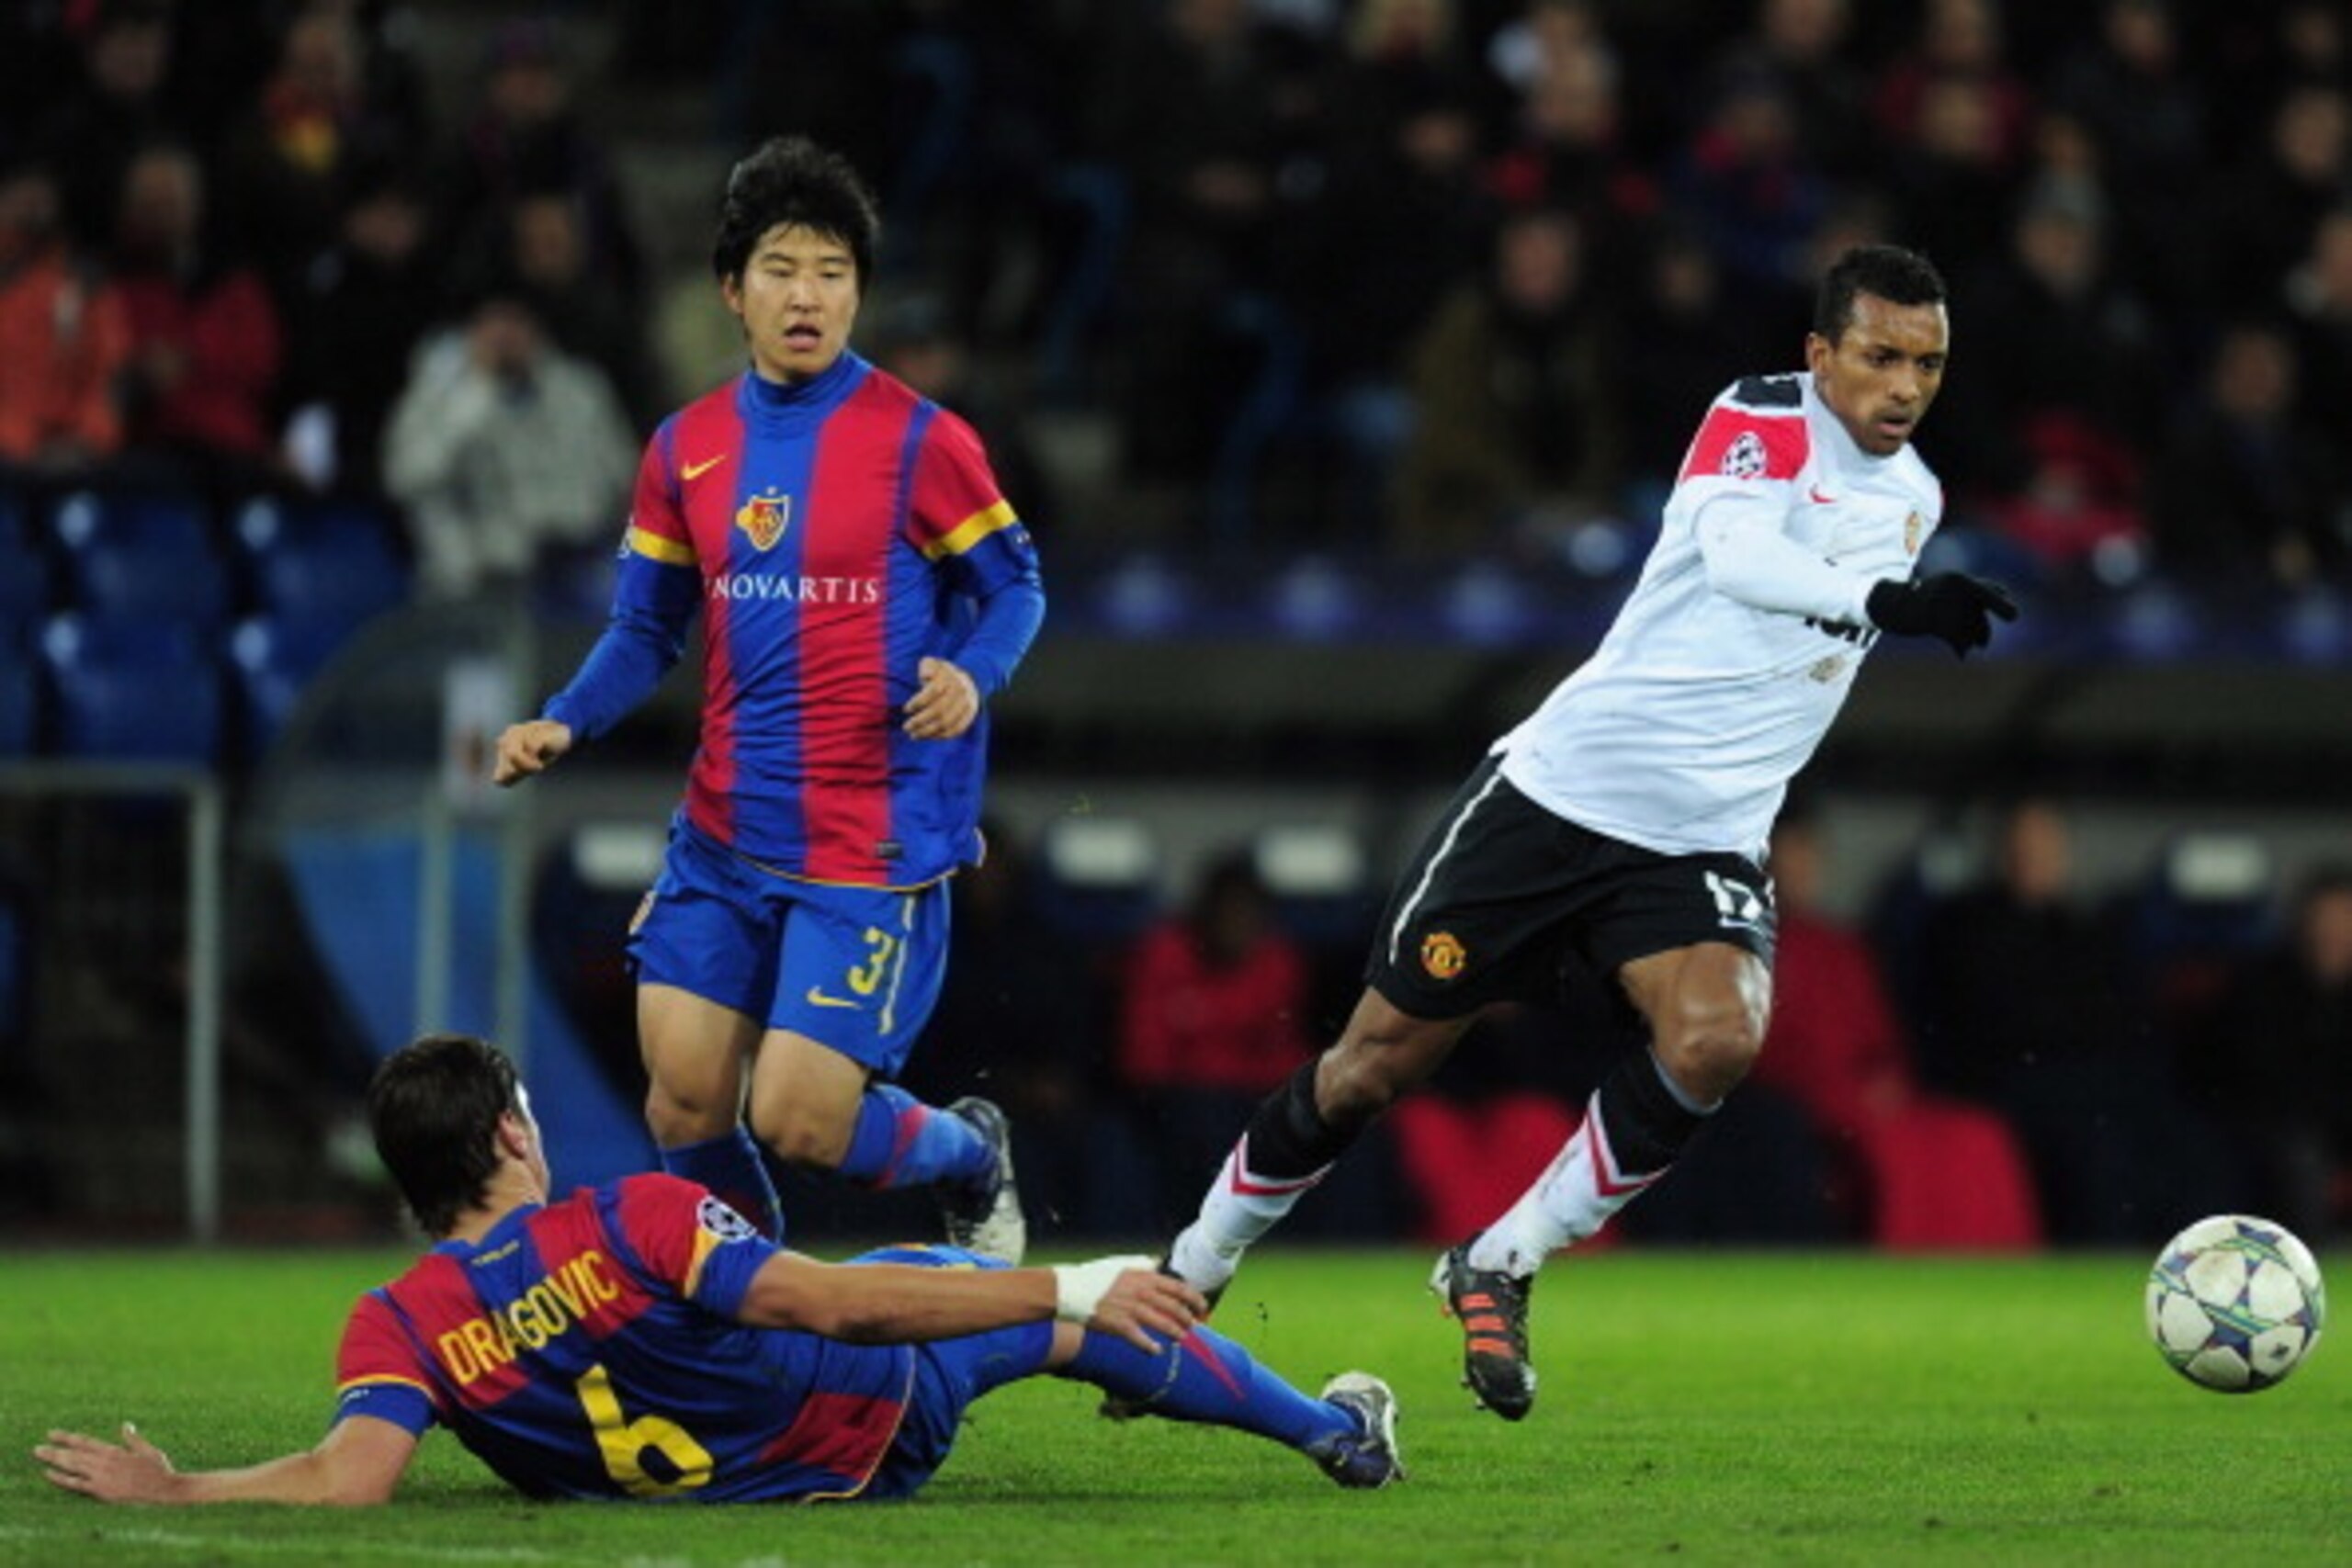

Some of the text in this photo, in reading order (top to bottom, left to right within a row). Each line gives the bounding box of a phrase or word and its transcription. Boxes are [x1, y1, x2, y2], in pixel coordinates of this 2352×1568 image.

[711, 573, 880, 604] NOVARTIS
[846, 926, 899, 996] 3
[438, 1250, 620, 1387] DRAGOVIC
[575, 1363, 716, 1497] 6
